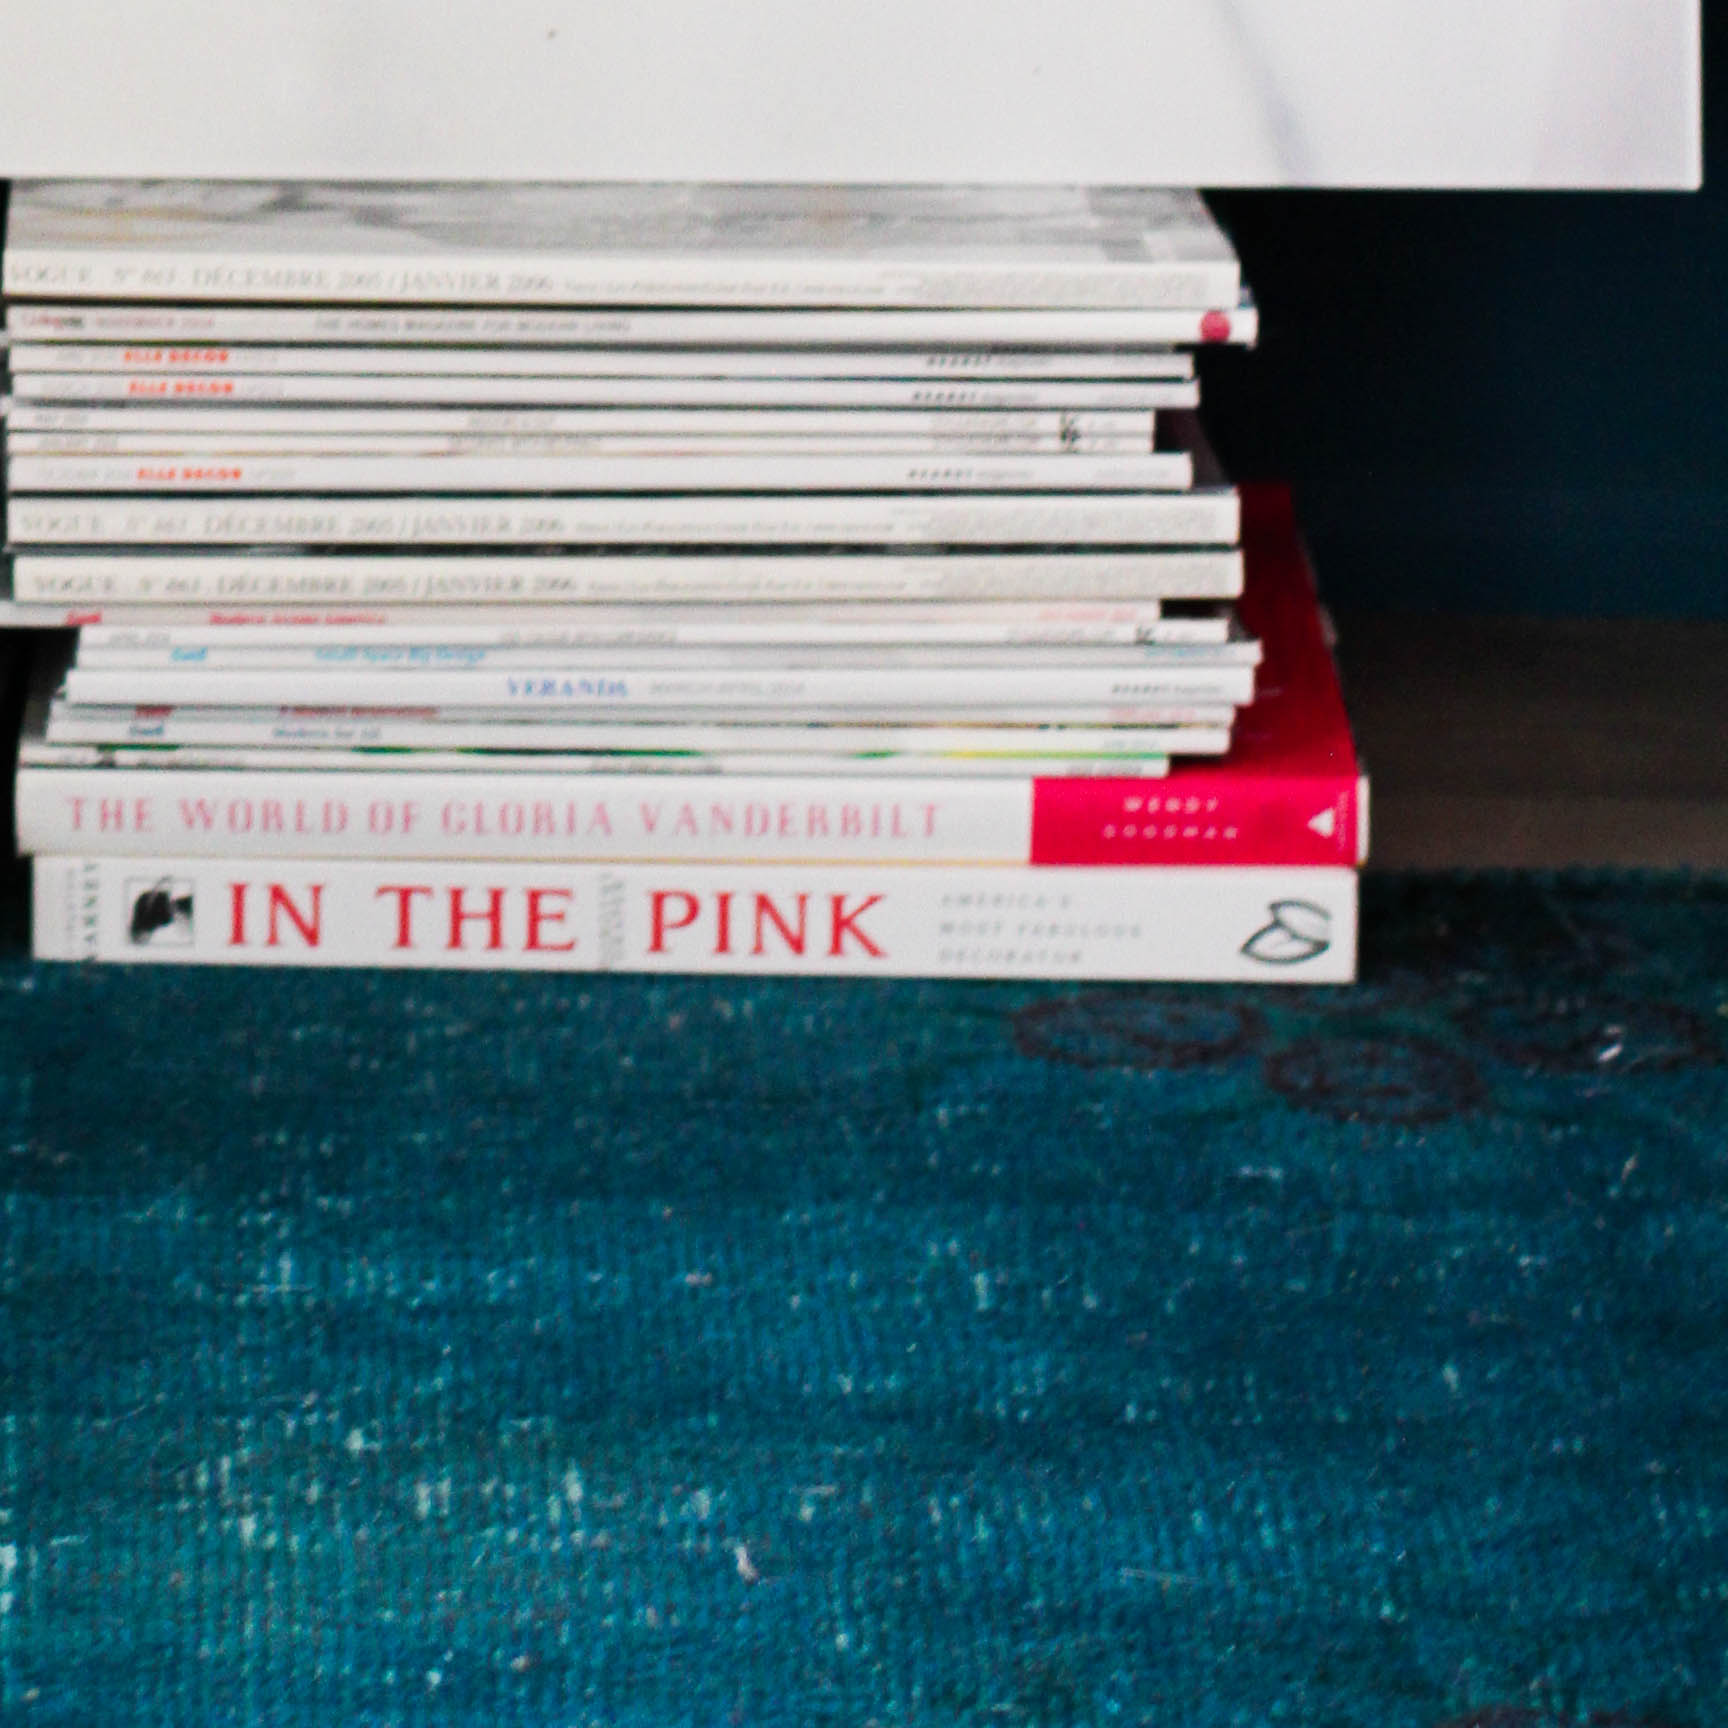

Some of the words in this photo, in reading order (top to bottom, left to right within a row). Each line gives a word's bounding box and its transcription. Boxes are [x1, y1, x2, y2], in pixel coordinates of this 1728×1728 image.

[66, 796, 154, 833] THE
[180, 796, 349, 835] WORLD
[368, 798, 422, 836] OF
[442, 798, 615, 837] GLORIA
[640, 800, 943, 839] VANDERBILT
[228, 882, 326, 946] IN
[374, 885, 576, 951] THE
[645, 888, 890, 959] PINK
